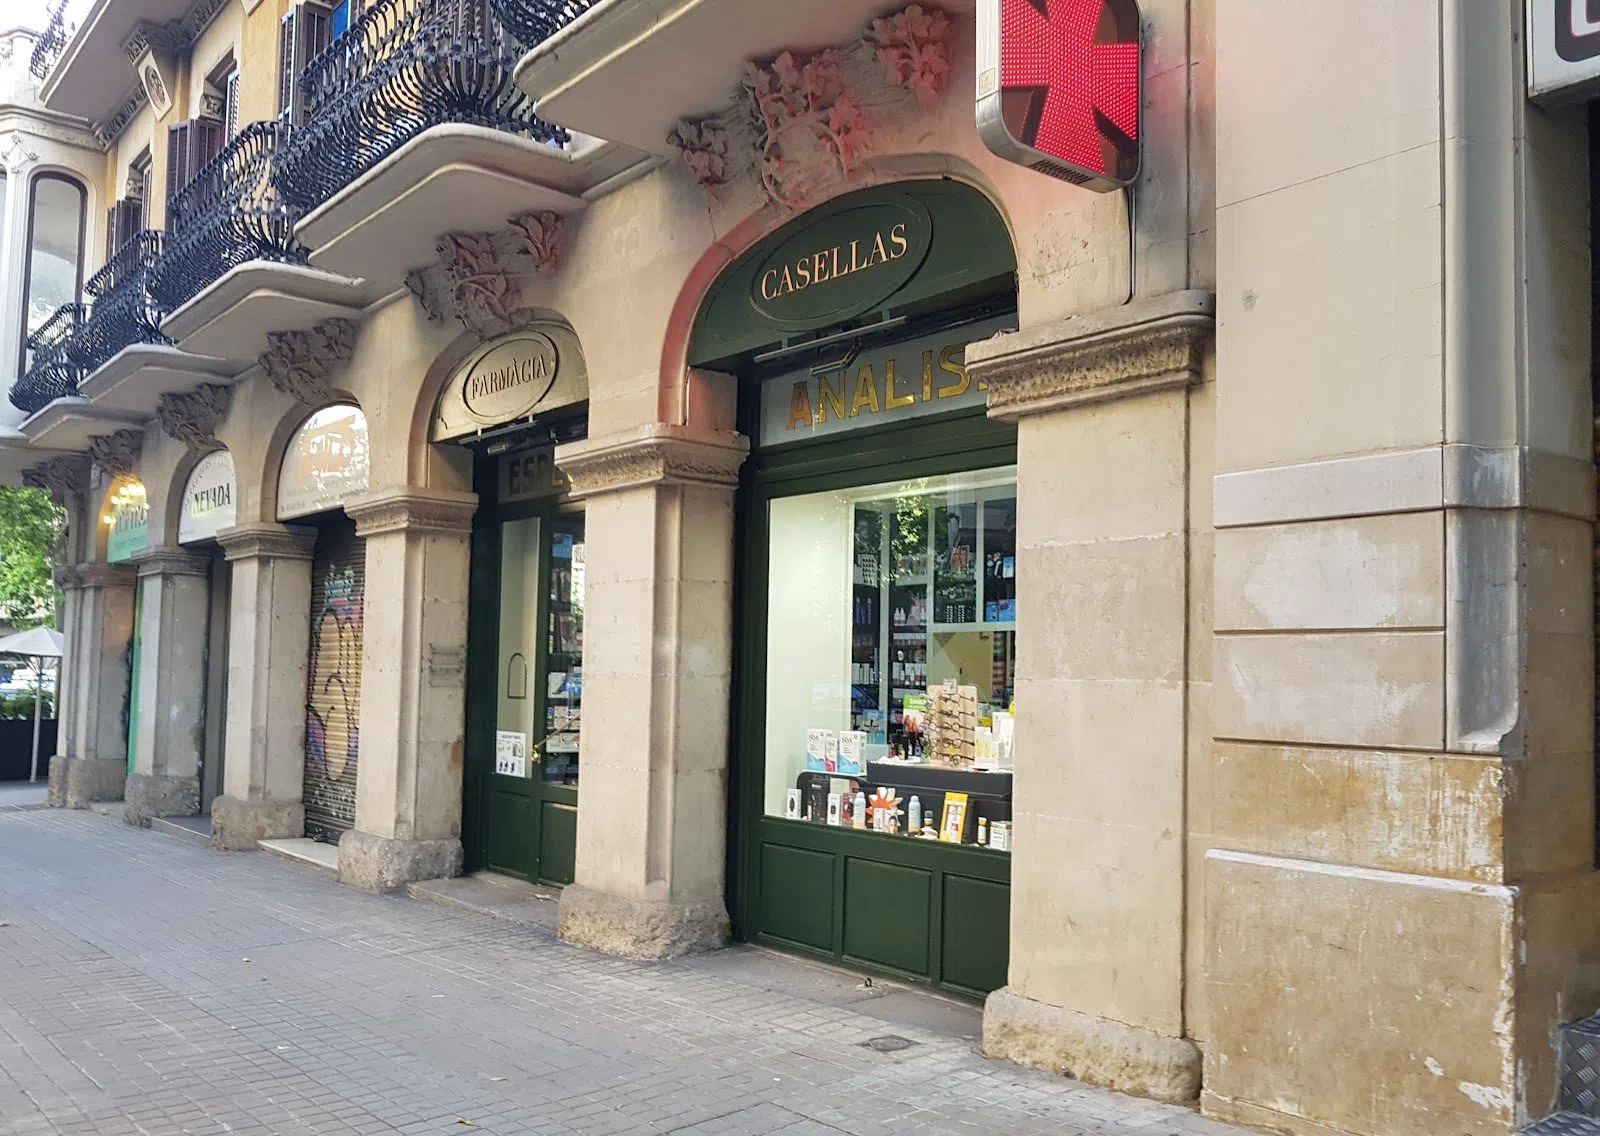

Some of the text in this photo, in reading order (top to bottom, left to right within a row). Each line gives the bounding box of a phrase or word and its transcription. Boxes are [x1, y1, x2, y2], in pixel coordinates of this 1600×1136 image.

[760, 223, 909, 301] CASELLAS
[470, 354, 548, 400] FARMÀCIA
[786, 341, 989, 431] ANALIS
[193, 482, 232, 514] NEVADA
